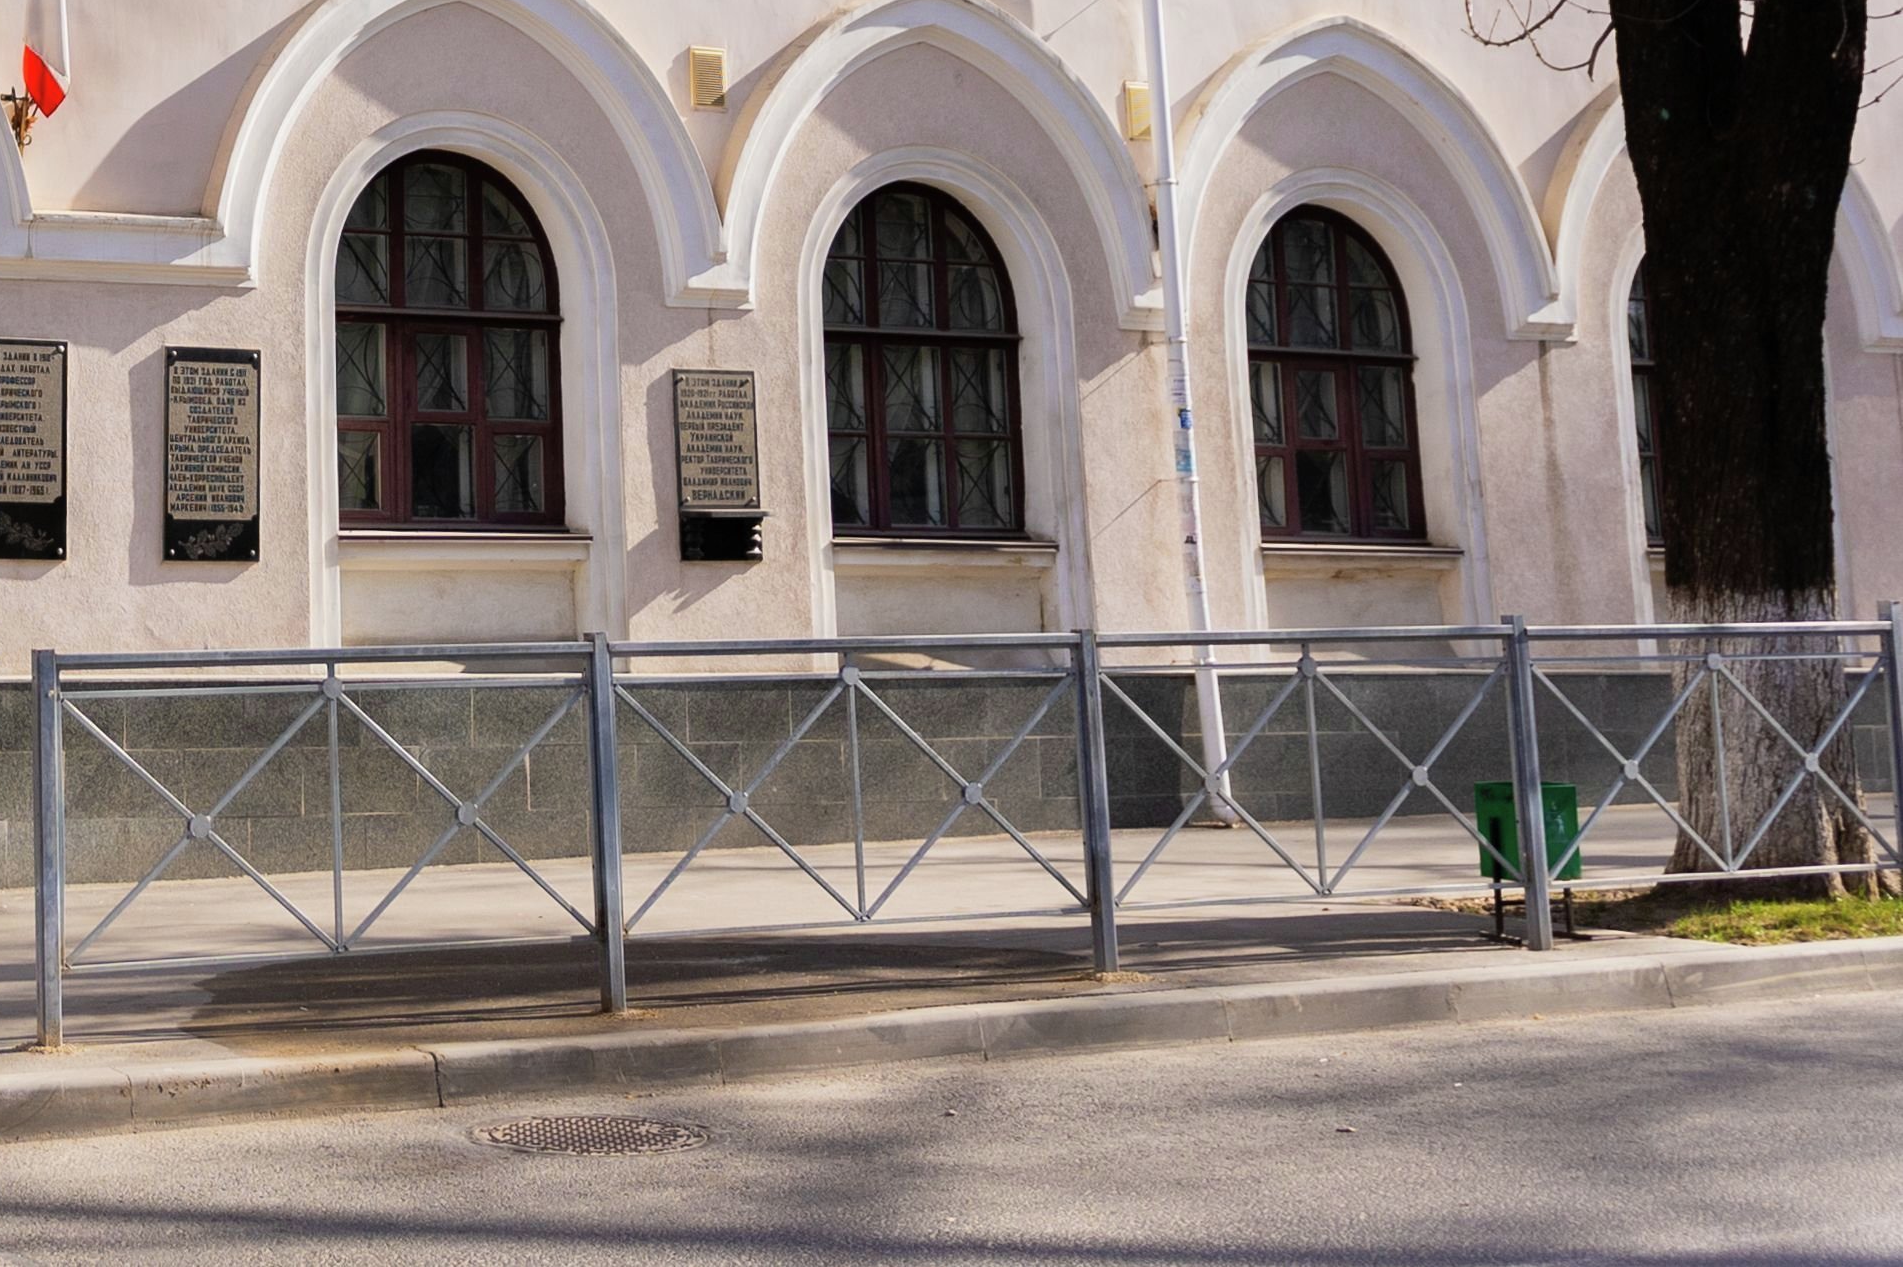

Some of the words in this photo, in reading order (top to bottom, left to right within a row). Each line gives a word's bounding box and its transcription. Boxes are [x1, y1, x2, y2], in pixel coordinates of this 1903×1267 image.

[3, 352, 30, 362] ЗДАНИИ
[19, 365, 50, 374] РАБОТАЛ
[180, 366, 199, 375] ЭТОМ
[201, 367, 228, 377] ЗДАНИИ
[198, 377, 212, 386] ГОД
[215, 377, 247, 387] РАБОТАЛ
[691, 377, 710, 387] ЭТОМ
[711, 378, 738, 387] ЗДАНИИ
[171, 385, 220, 396] ВЫДАЮЩИЙСЯ
[718, 389, 748, 399] РАБОТАЛ
[680, 399, 716, 408] АКАДЕМИК
[189, 406, 234, 415] СОЗДАТЕЛЕЙ
[686, 411, 723, 420] АКАДЕМИИ
[187, 415, 238, 425] ТАВРИЧЕСКОГО
[679, 421, 705, 431] ПЕРВЫЙ
[706, 422, 744, 431] ПРЕЗИДЕНТ
[169, 434, 222, 444] ЦЕНТРАЛЬНОГО
[223, 436, 250, 444] АРХИВА
[690, 432, 733, 442] УКРАИНСКОЙ
[198, 445, 251, 455] ПРЕДСЕДАТЕЛЬ
[686, 443, 723, 452] АКАДЕМИИ
[170, 453, 217, 463] ТАВРИЧЕСКОЙ
[218, 455, 243, 464] УЧЕНОЙ
[681, 455, 704, 464] РЕКТОР
[21, 461, 31, 470] АН
[34, 462, 51, 470] УССР
[170, 463, 204, 472] АРХИВНОЙ
[700, 466, 747, 476] УНИВЕРСИТЕТА
[169, 473, 244, 483] ЧЛЕН-КОРРЕСПОНДЕНТ
[683, 476, 718, 487] ВЛАДИМИР
[720, 477, 752, 487] ИВАНОВИЧ
[169, 483, 206, 492] АКАДЕМИИ
[208, 484, 226, 492] НАУК
[228, 485, 245, 493] СССР
[175, 492, 207, 502] АРСЕНИЙ
[211, 494, 245, 503] ИВАНОВИЧ
[691, 487, 746, 501] ВЕРНАДСКИЙ
[169, 502, 207, 512] МАРКЕВИЧ
